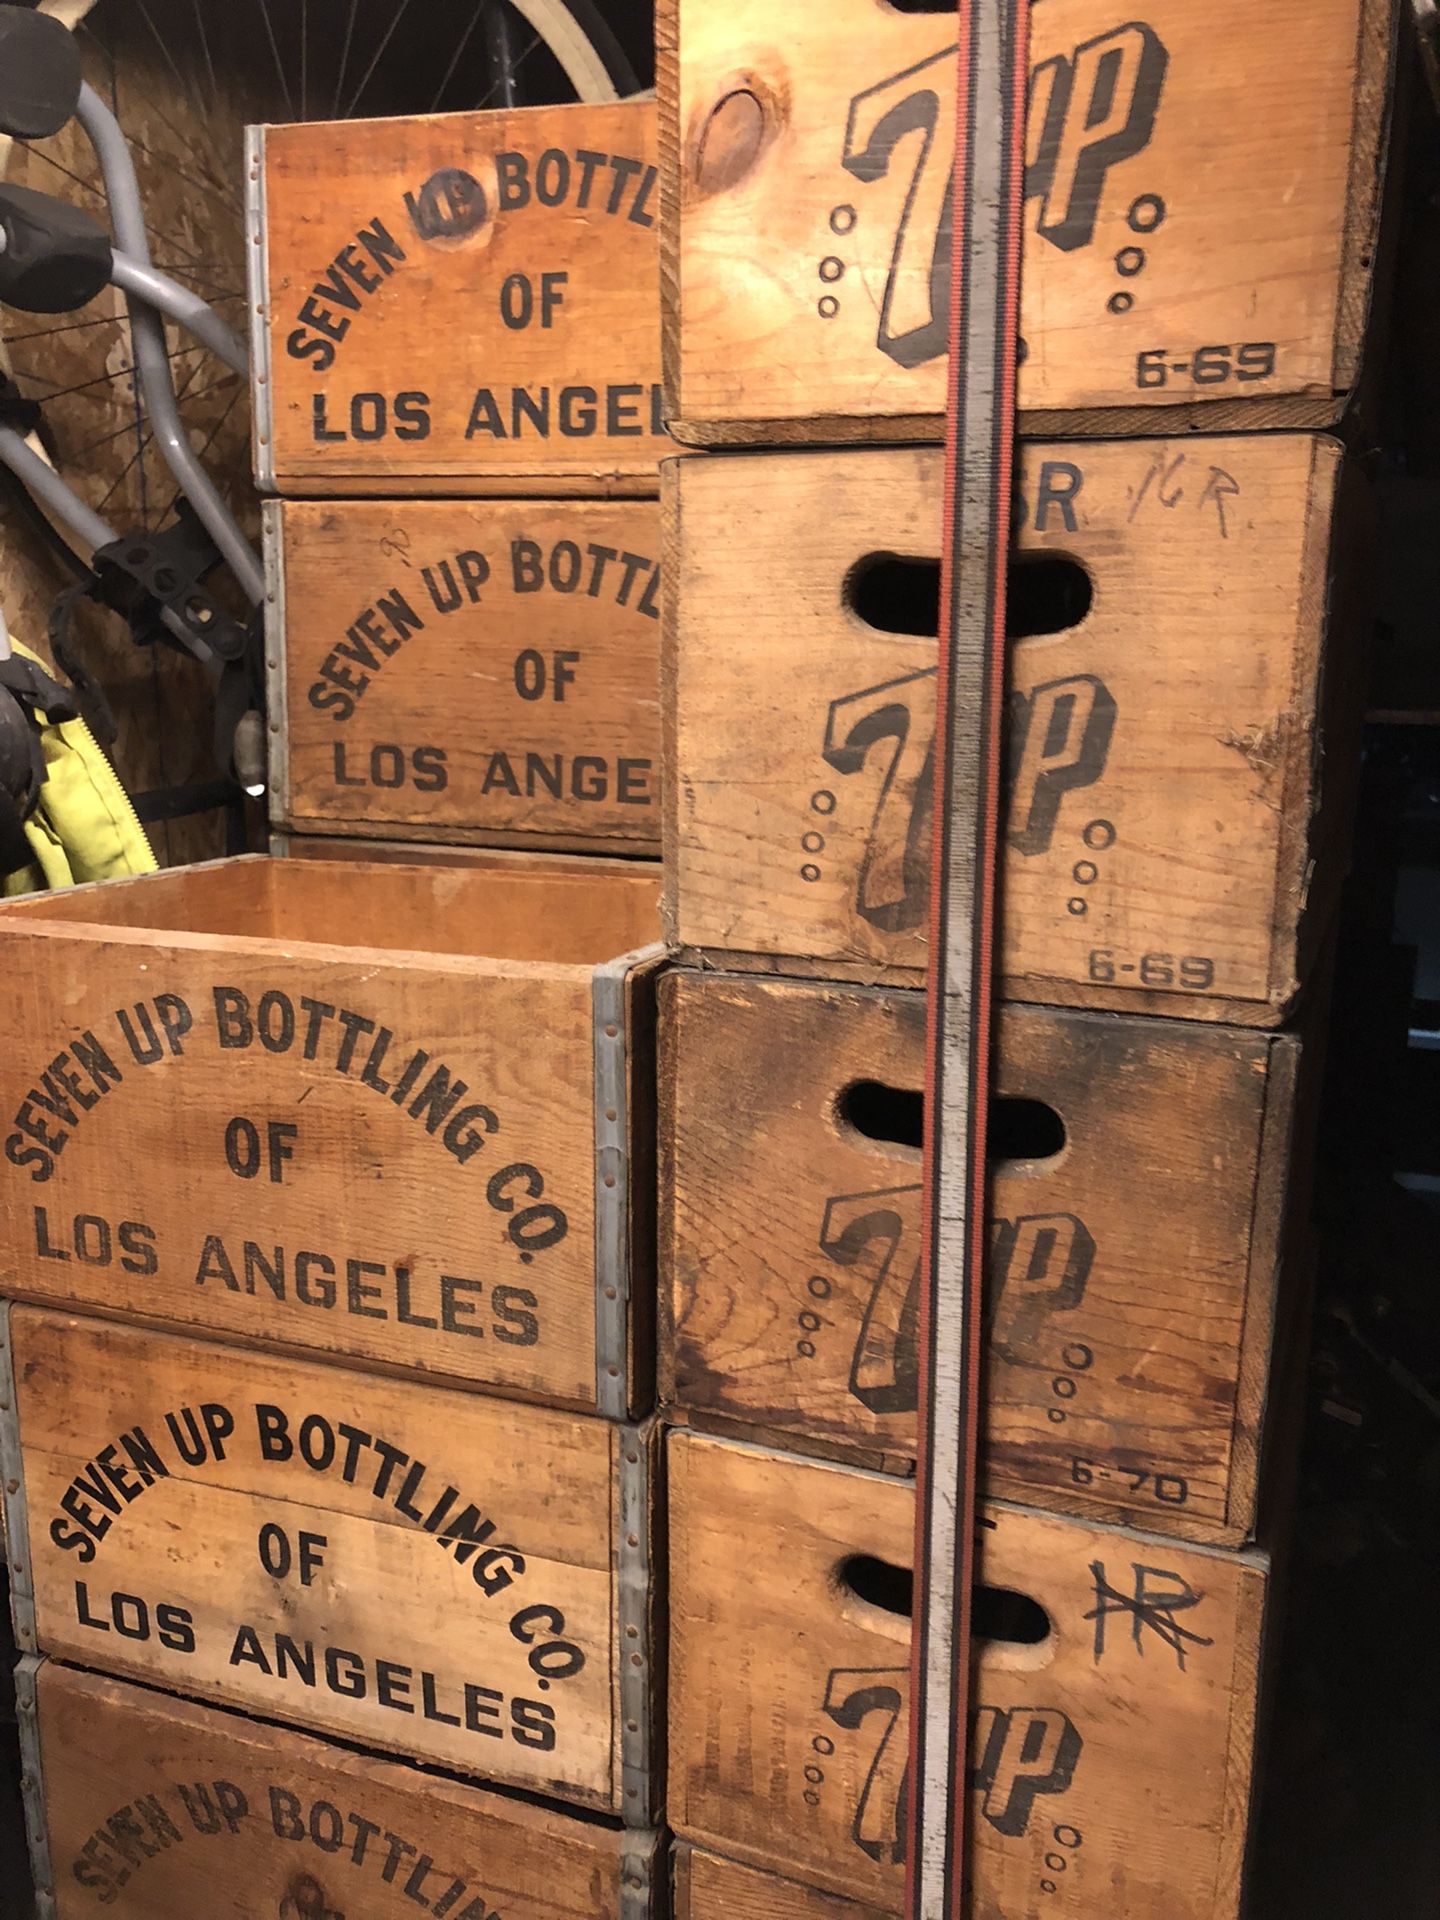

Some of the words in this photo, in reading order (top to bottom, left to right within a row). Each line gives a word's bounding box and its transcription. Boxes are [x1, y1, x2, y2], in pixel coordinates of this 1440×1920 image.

[286, 217, 406, 371] SEVEN
[501, 272, 568, 329] OF
[1136, 342, 1276, 388] 6-69
[313, 392, 430, 440] LOS
[308, 588, 425, 721] SEVEN
[420, 550, 490, 613] UP
[513, 648, 580, 701] OF
[333, 742, 449, 792] LOS
[1089, 949, 1215, 990] 6-69
[4, 1030, 124, 1182] SEVEN
[116, 993, 193, 1065] UP
[212, 986, 500, 1164] BOTTLING
[486, 1163, 568, 1264] CO.
[225, 1117, 298, 1182] OF
[33, 1206, 158, 1275] LOS
[196, 1235, 540, 1347] ANGELES
[1070, 1457, 1188, 1502] 6-70
[50, 1427, 169, 1564] SEVEN
[164, 1403, 234, 1466] UP
[256, 1403, 527, 1597] BOTTLING
[509, 1604, 586, 1691] CO.
[259, 1522, 328, 1586] OF
[75, 1580, 196, 1653] LOS
[229, 1624, 556, 1752] ANGELES
[73, 1792, 184, 1903] SEVEN
[177, 1780, 249, 1836] UP
